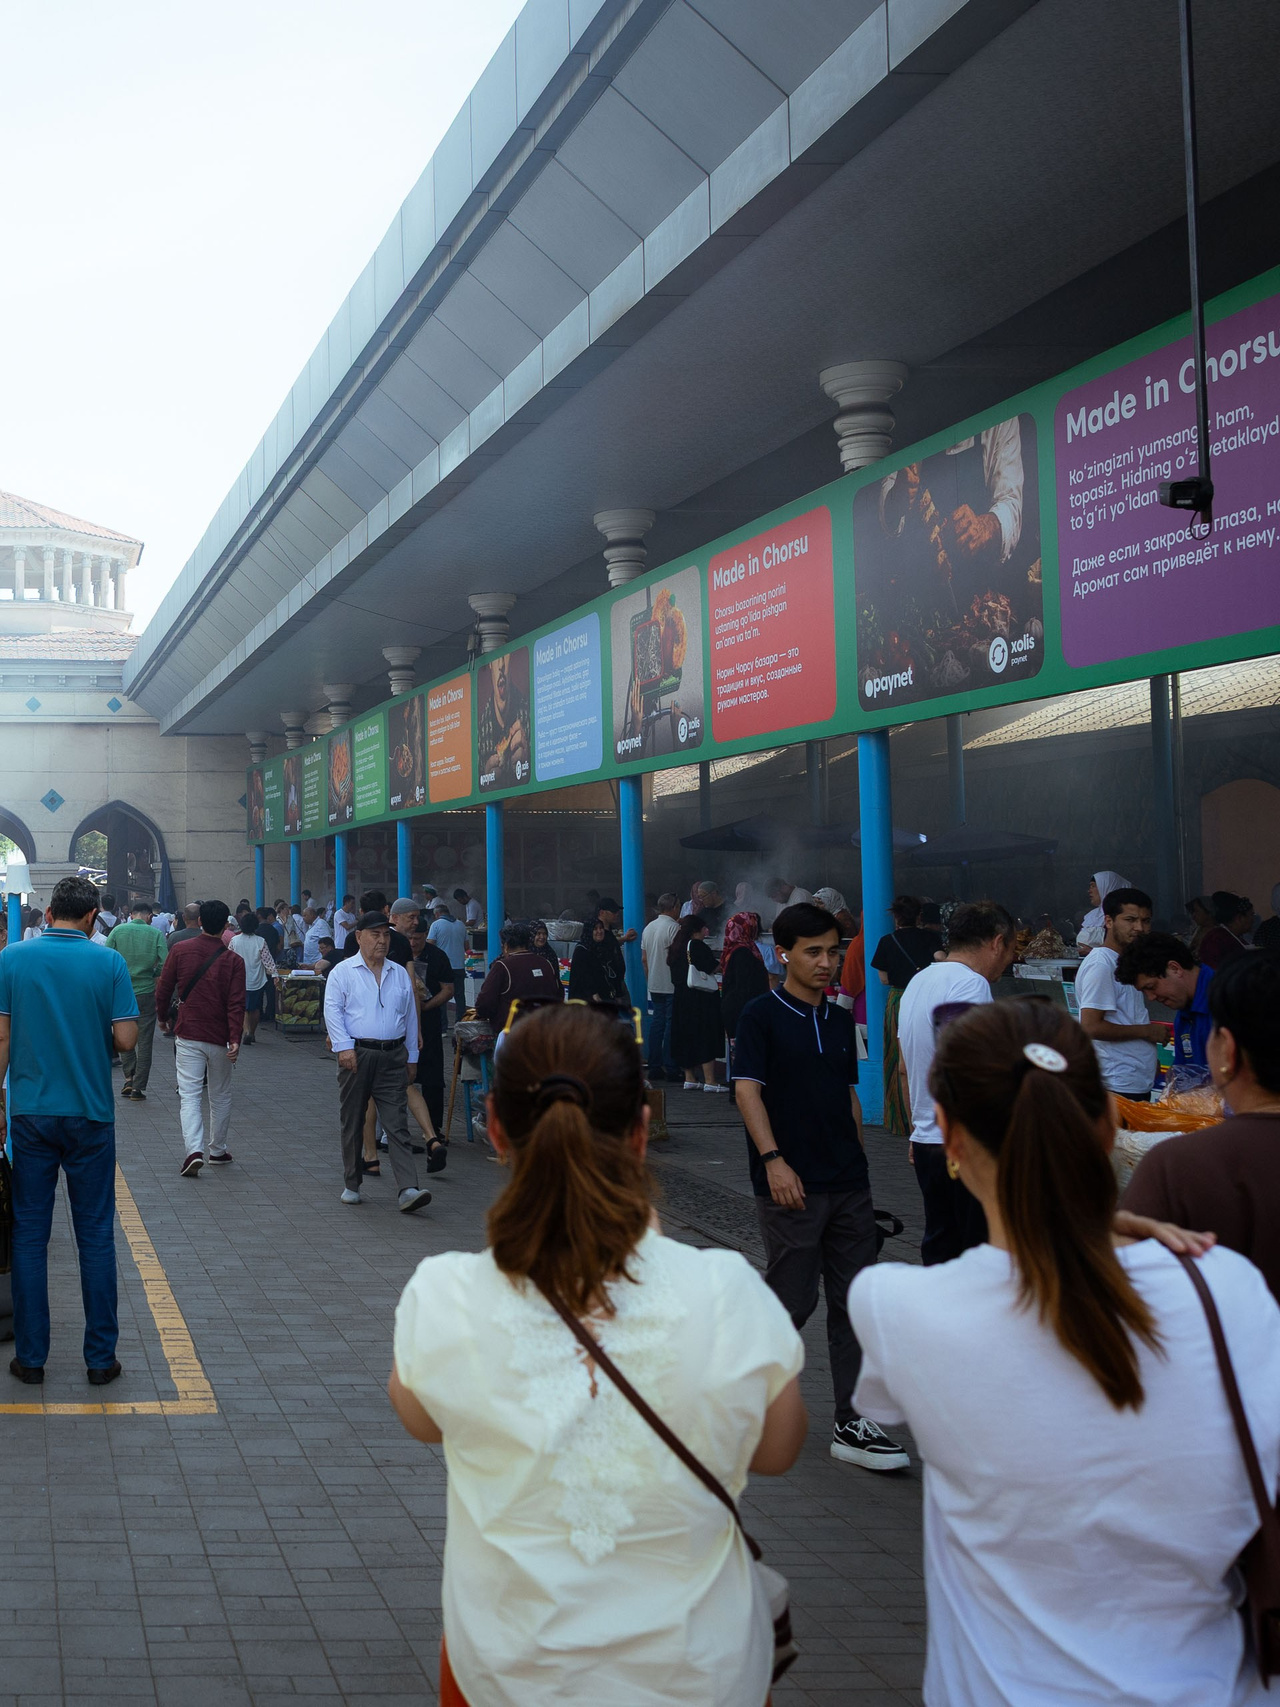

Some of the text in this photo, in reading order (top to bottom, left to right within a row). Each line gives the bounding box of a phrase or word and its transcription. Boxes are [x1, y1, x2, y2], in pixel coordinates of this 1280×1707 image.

[1066, 391, 1136, 444] Made
[1145, 375, 1168, 410] in
[1216, 401, 1254, 429] ham,
[1069, 482, 1117, 508] topasiz.
[1121, 459, 1171, 489] Hidning
[1072, 553, 1105, 574] Даже
[1109, 543, 1139, 563] если
[1144, 521, 1209, 553] закроете
[1213, 505, 1261, 532] глаза,
[713, 534, 808, 591] Made in Chorsu
[1073, 531, 1280, 598] Аромат сам приведёт к нему.
[714, 581, 785, 620] Chorsu bozorining norini
[715, 619, 738, 635] ustaning
[762, 601, 786, 621] pishgan
[536, 632, 587, 667] Made in Chorsu
[736, 633, 743, 643] va
[1011, 634, 1035, 654] xolis
[716, 647, 799, 680] Норин Чорсу базара это
[1011, 654, 1028, 666] paynet
[717, 662, 802, 696] традиция и вкус, созданные
[873, 665, 913, 698] paynet
[429, 687, 463, 712] Made in Chorsu
[717, 690, 769, 713] руками мастеров.
[688, 717, 700, 730] xolis
[621, 734, 642, 755] paynet
